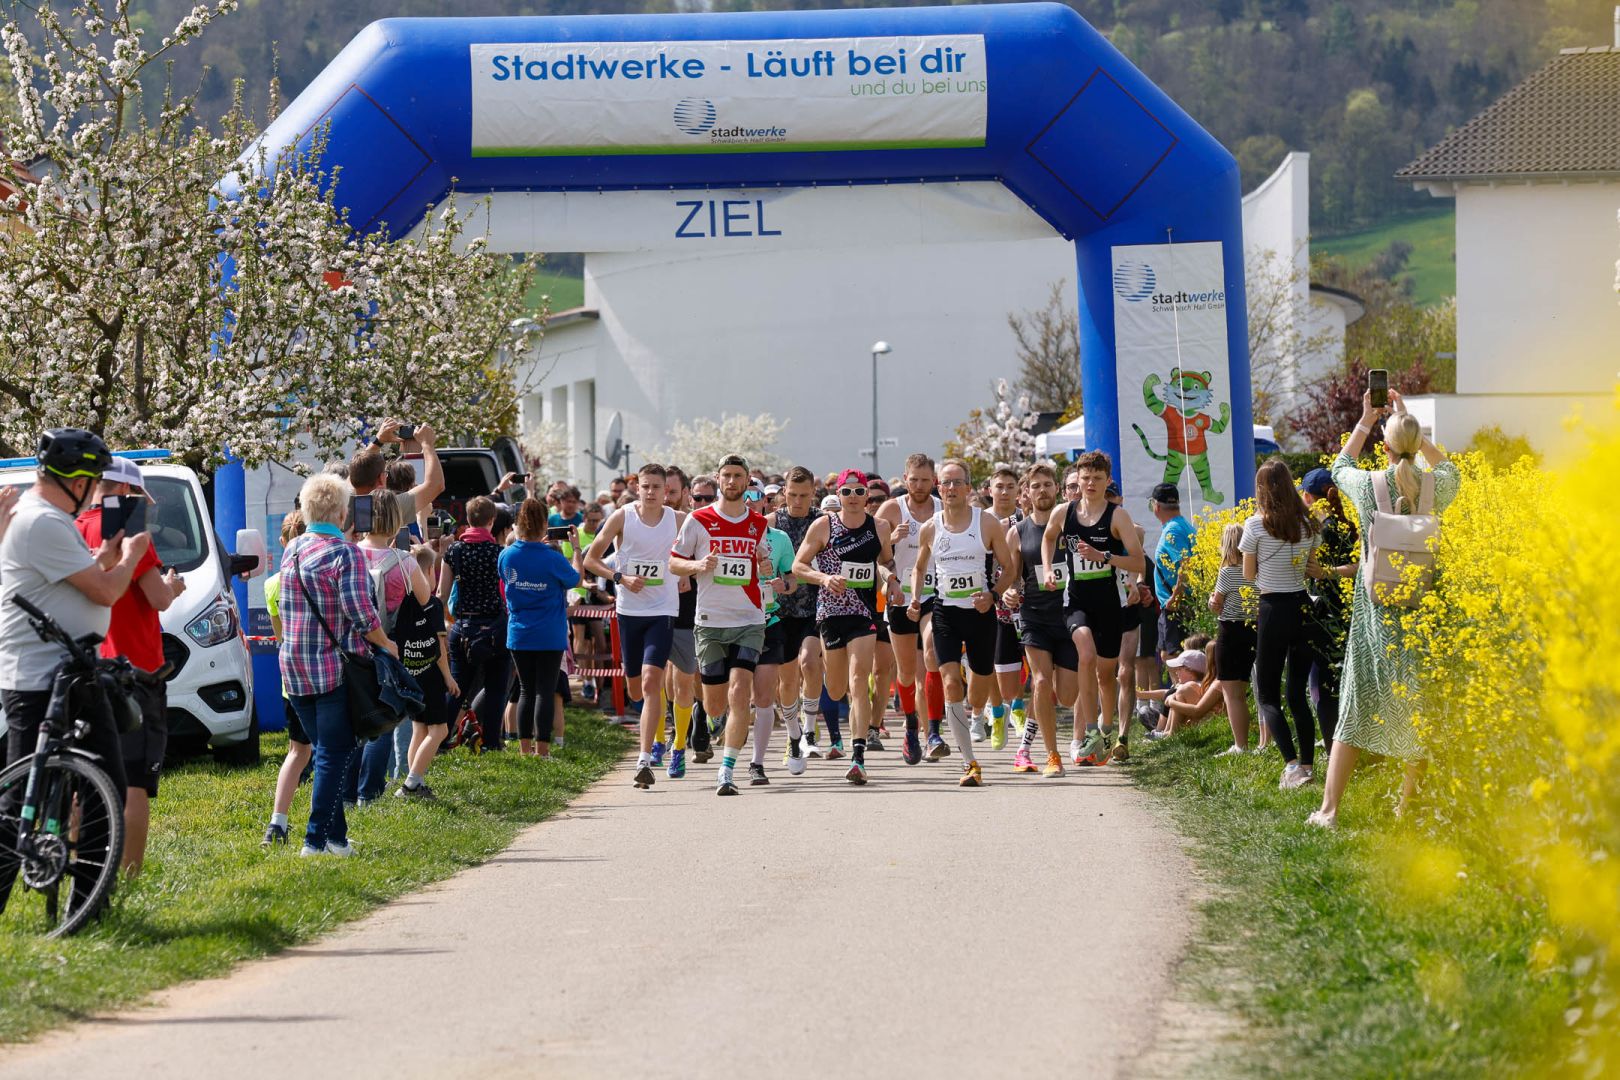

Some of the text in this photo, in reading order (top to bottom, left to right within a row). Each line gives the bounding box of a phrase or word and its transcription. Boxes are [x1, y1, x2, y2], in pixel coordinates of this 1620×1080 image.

[492, 54, 705, 81] Stadtwerke
[747, 50, 835, 77] Läuft
[848, 49, 906, 76] bei
[920, 47, 966, 73] dir
[851, 78, 986, 95] und du bei uns
[711, 126, 787, 138] stadtwerke
[675, 200, 782, 238] ZIEL
[1152, 289, 1225, 305] stadtwerke
[709, 539, 756, 555] REWE
[635, 564, 659, 577] 172
[722, 563, 746, 577] 143
[848, 568, 871, 580] 160
[949, 576, 974, 590] 291
[403, 649, 424, 658] Run.
[1023, 721, 1039, 746] YEAH
